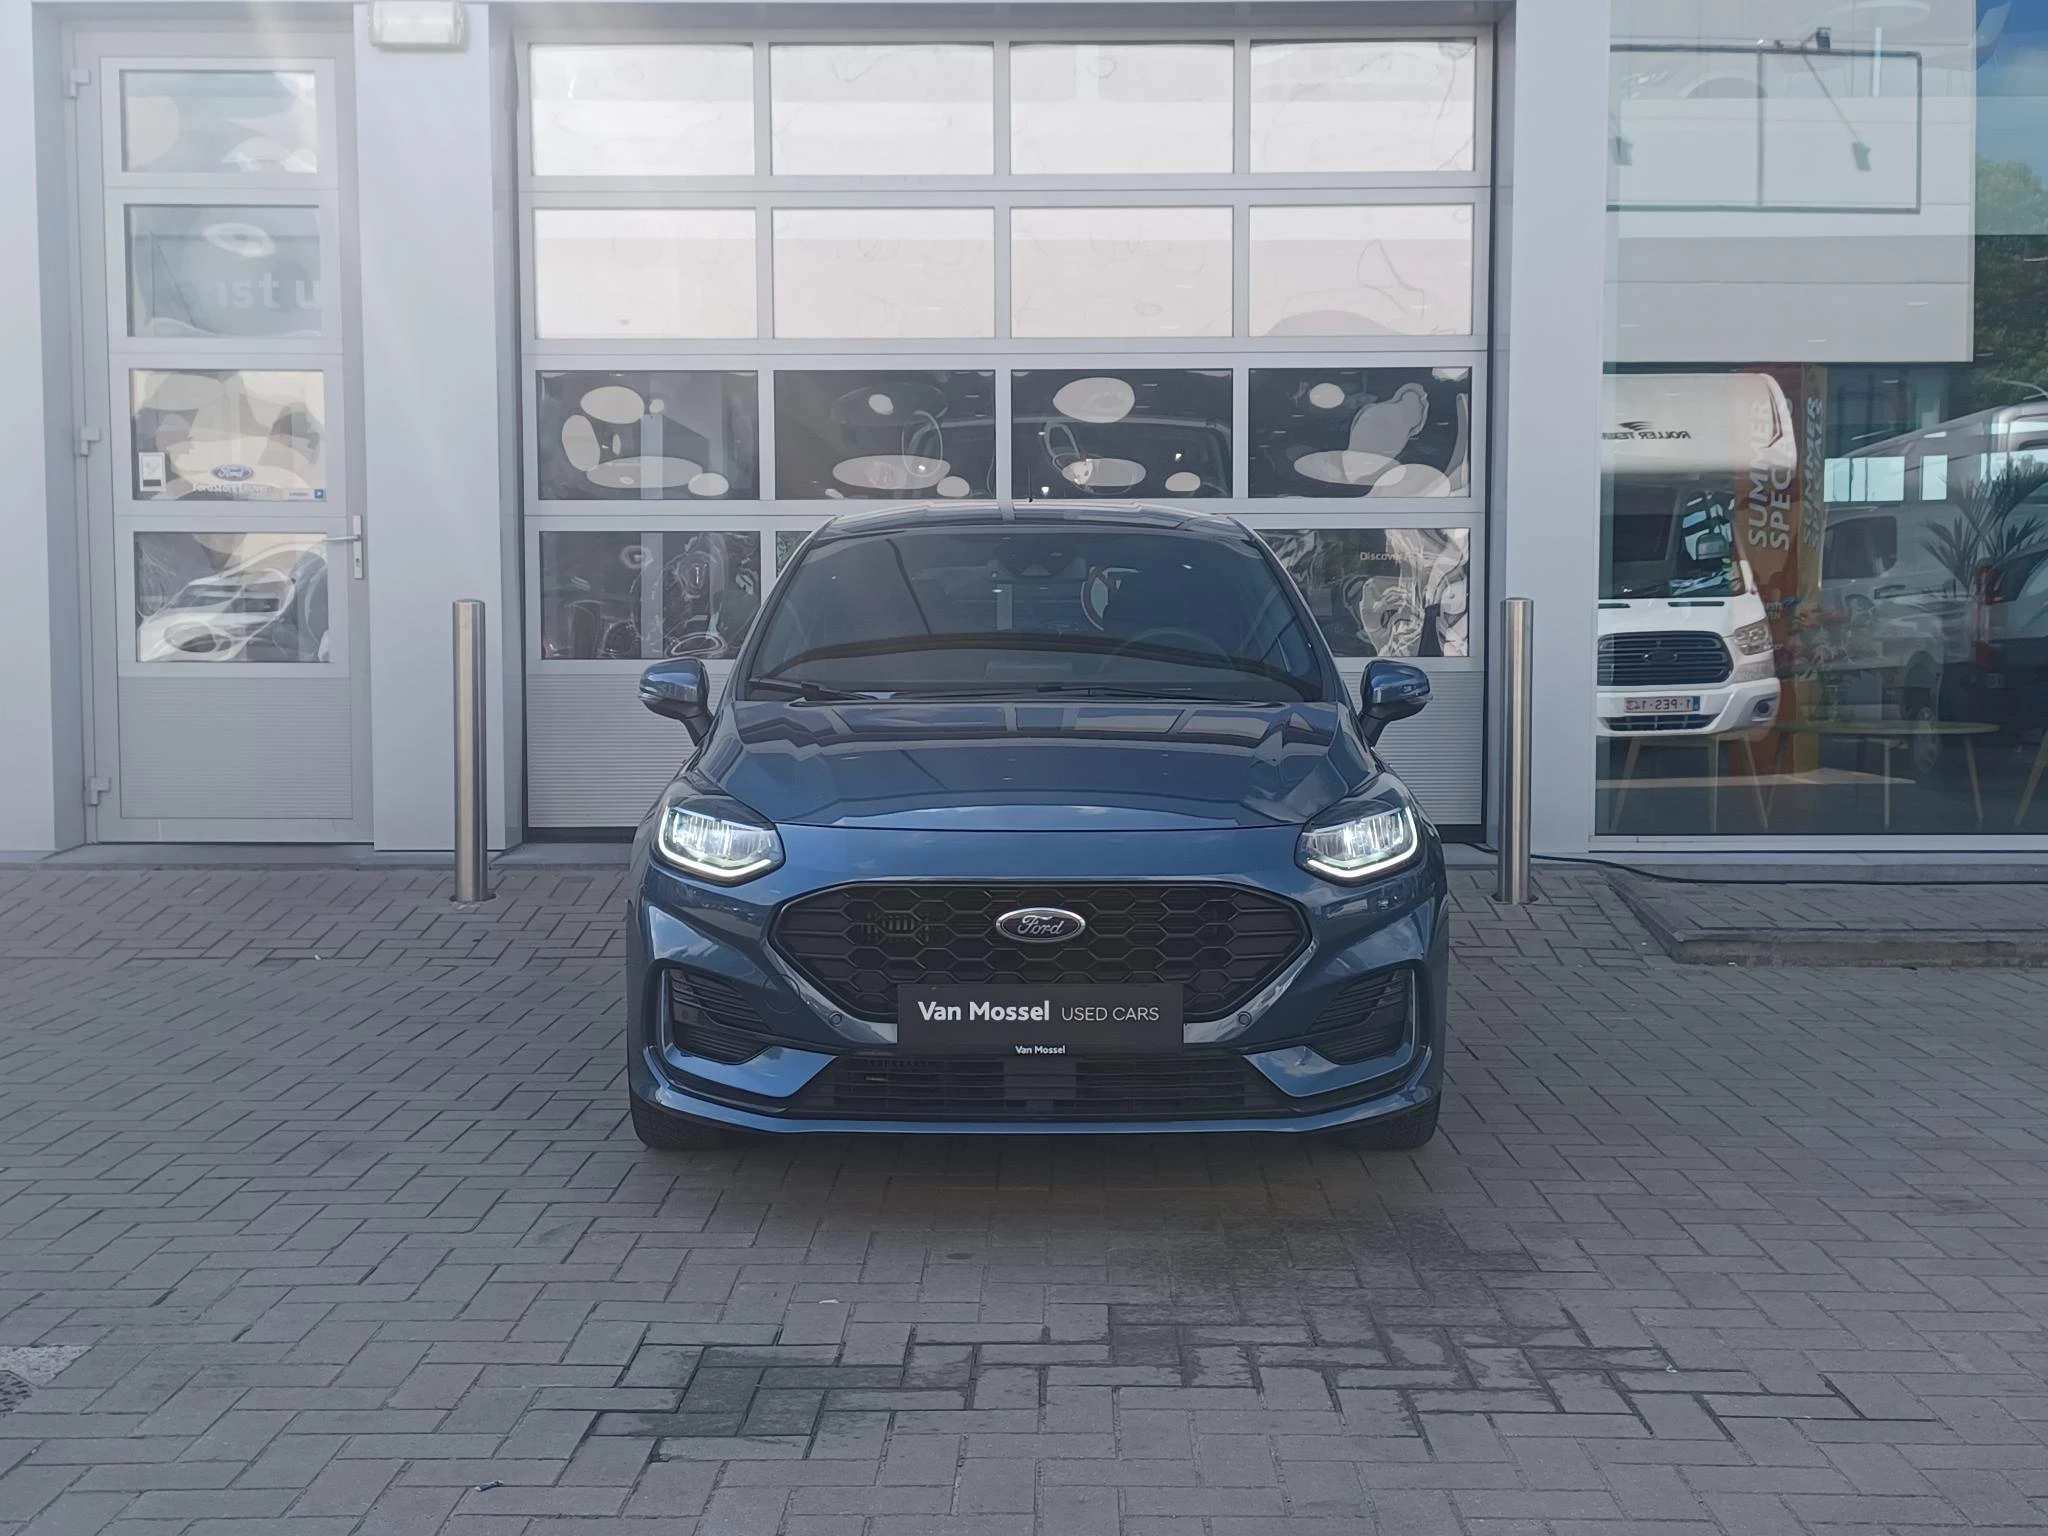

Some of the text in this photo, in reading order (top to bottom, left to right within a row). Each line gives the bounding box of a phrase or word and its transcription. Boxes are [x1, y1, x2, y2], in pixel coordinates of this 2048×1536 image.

[1748, 399, 1770, 548] SUMMER
[1017, 914, 1064, 935] Ford
[917, 1000, 1160, 1022] Van Mossel USED CARS
[1015, 1045, 1066, 1055] Van Mossel
